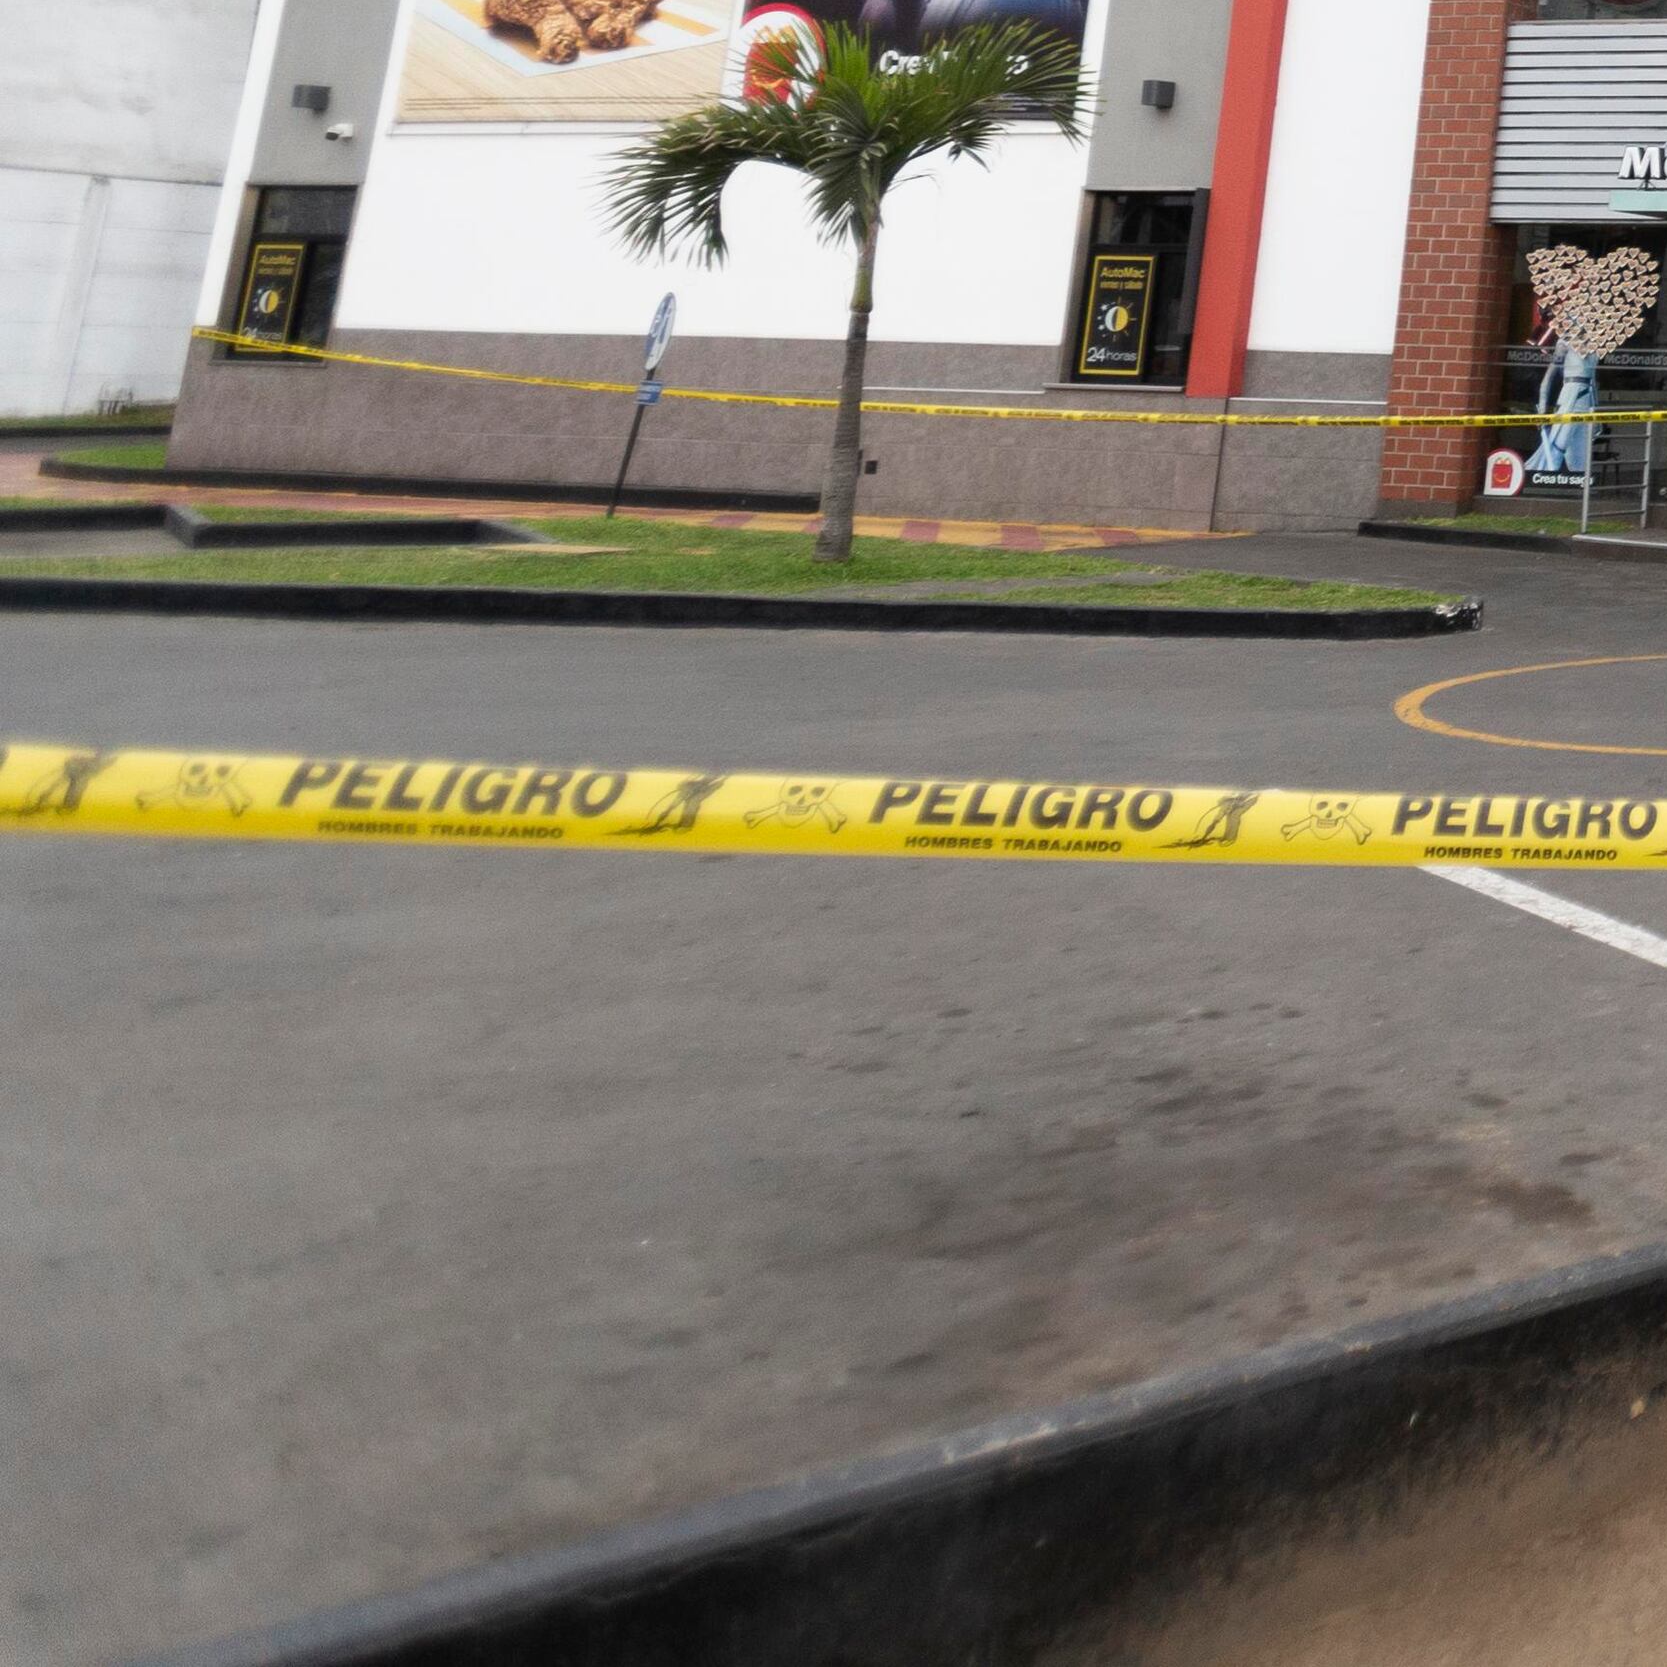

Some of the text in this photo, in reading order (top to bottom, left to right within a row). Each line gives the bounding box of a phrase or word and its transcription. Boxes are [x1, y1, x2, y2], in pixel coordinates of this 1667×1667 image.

[1100, 266, 1146, 279] AutoMac
[1532, 473, 1555, 484] Crea
[1557, 474, 1569, 484] tu
[279, 759, 628, 819] PELIGRO
[867, 781, 1175, 832] PELIGRO
[1391, 796, 1660, 841] PELIGRO
[317, 819, 564, 840] HOMBRES TRABAJANDO
[905, 836, 1122, 853] HOMBRES TRABAJANDO
[1424, 845, 1618, 861] HOMBRES TRABAJANDO
